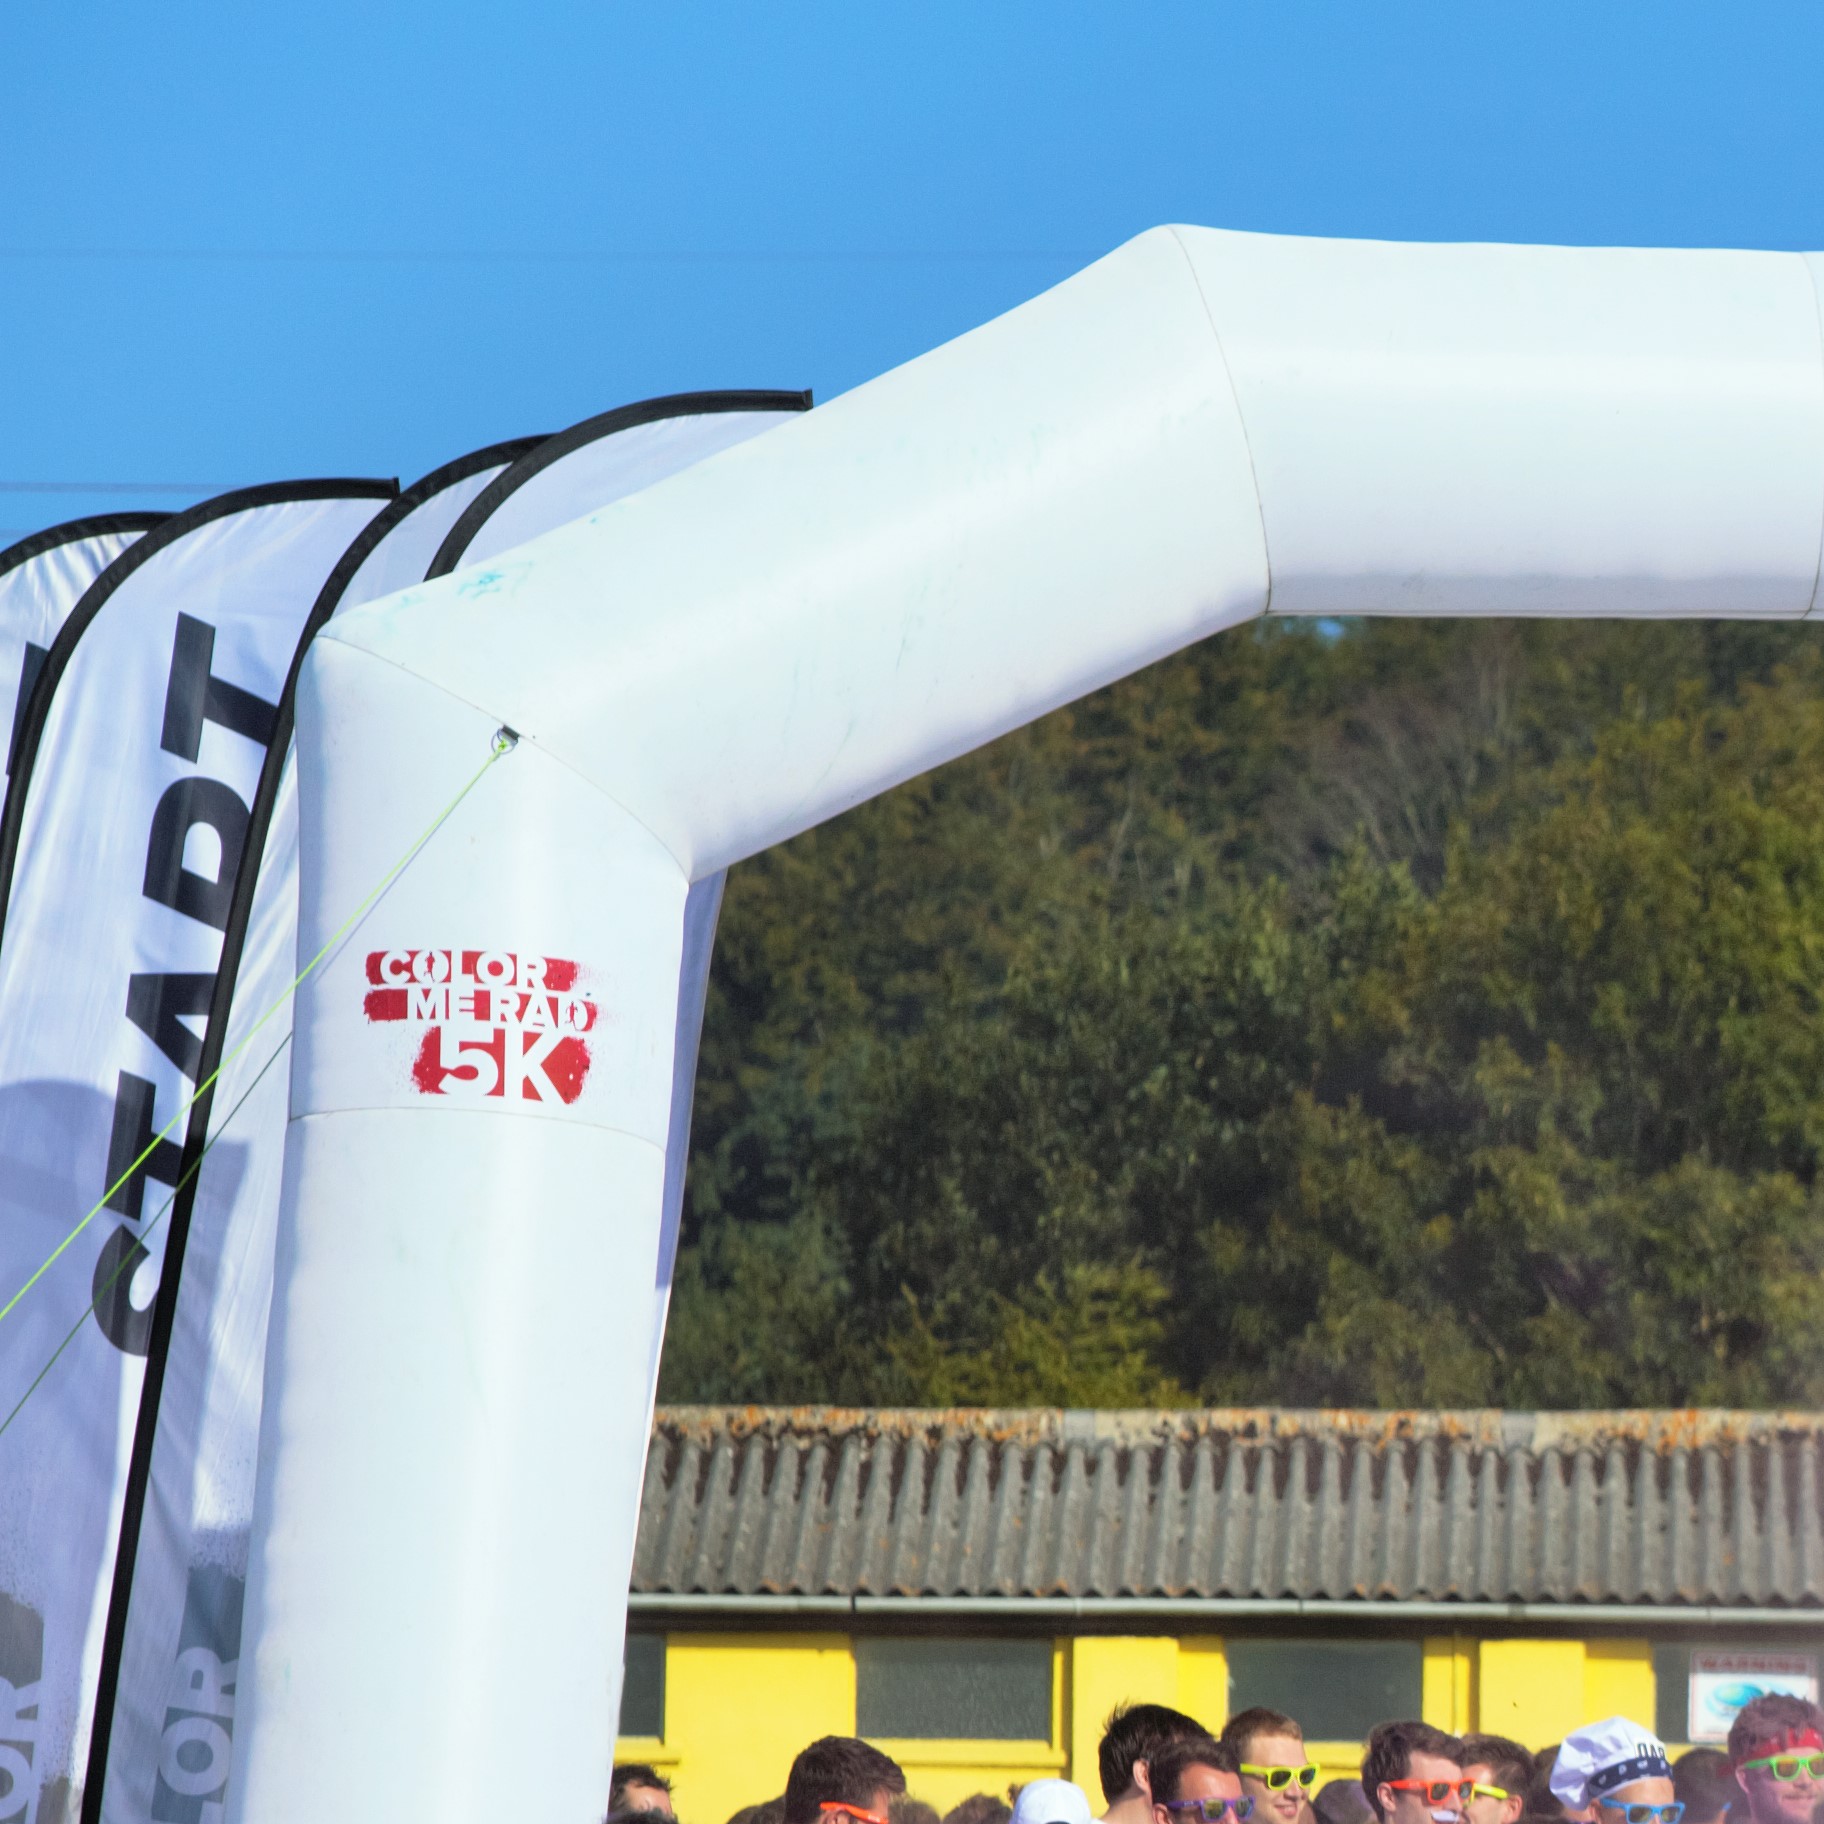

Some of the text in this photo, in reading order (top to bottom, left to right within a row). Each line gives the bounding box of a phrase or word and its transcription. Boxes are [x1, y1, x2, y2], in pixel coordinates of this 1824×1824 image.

[380, 949, 549, 990] COLOR
[407, 988, 589, 1032] ME RAD
[438, 1025, 567, 1105] 5K
